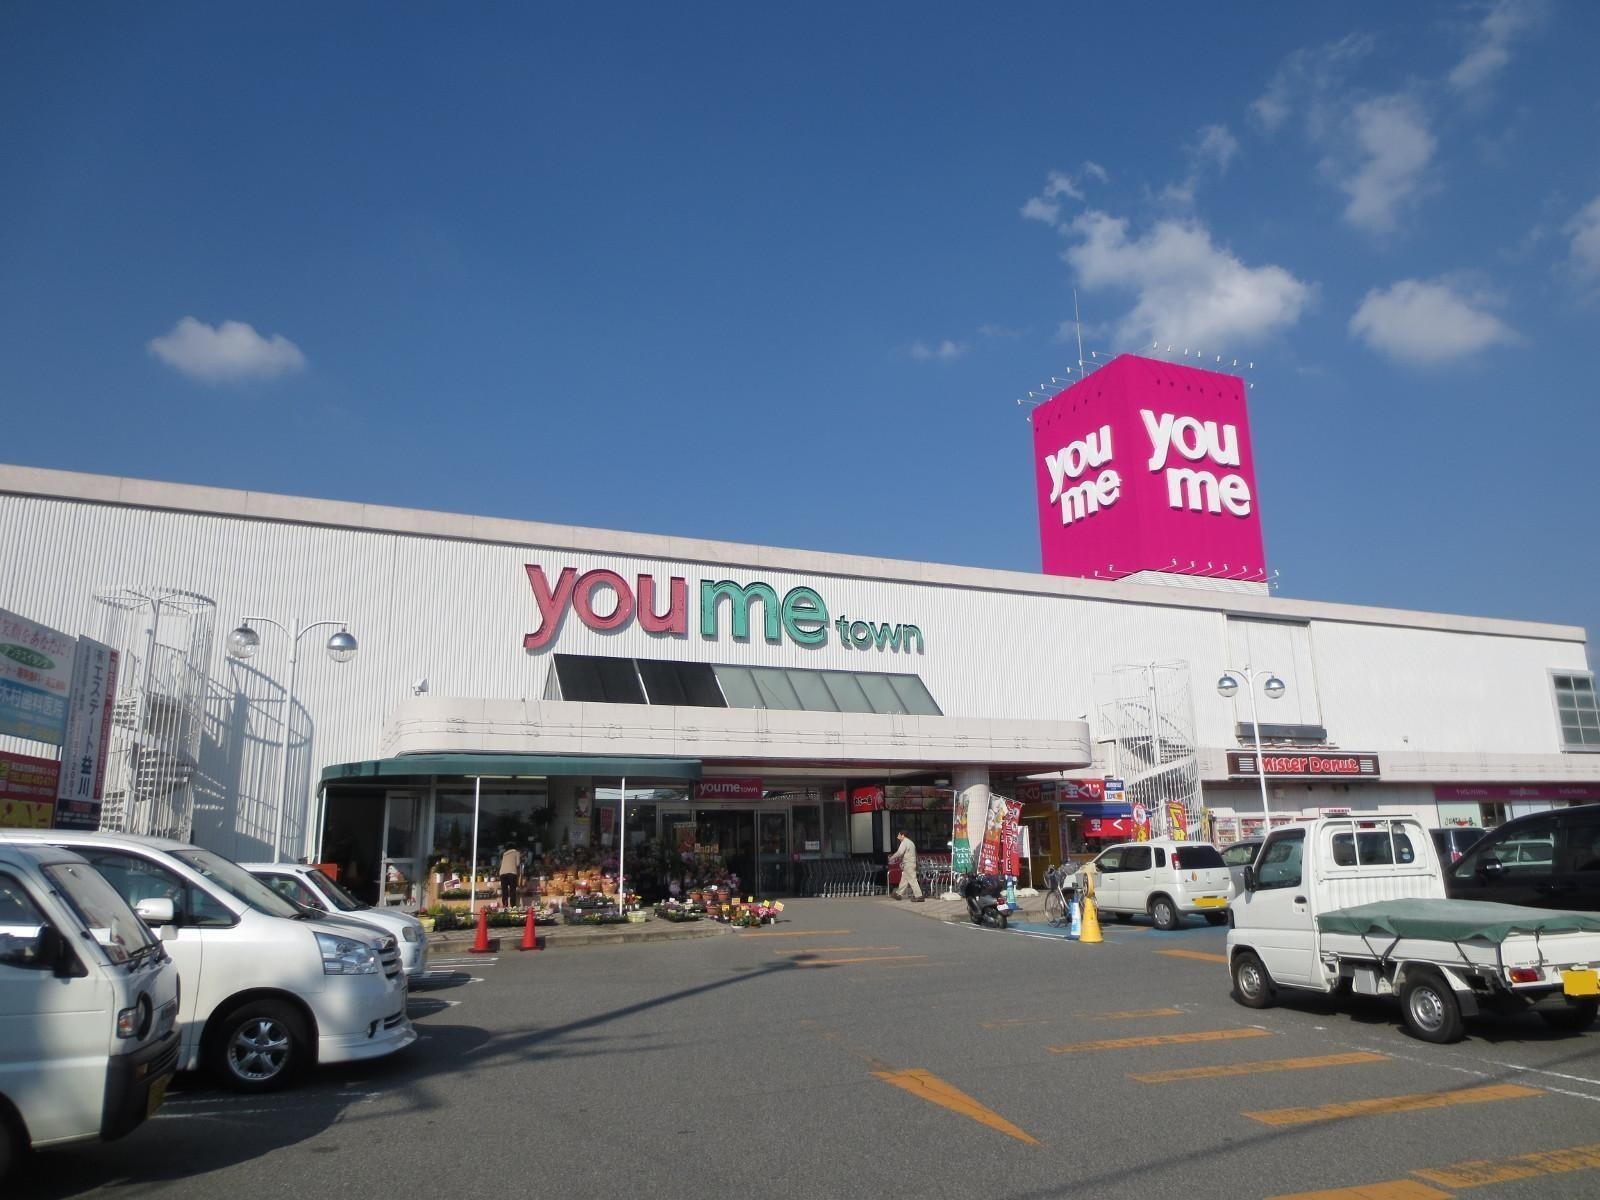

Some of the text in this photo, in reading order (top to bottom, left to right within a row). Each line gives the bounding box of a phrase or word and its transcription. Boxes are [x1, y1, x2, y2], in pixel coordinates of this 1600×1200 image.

[1045, 424, 1113, 503] you
[1140, 408, 1240, 471] you
[1060, 469, 1121, 526] me
[1166, 467, 1251, 516] me
[834, 614, 923, 653] town
[1308, 756, 1360, 773] Donut
[1065, 783, 1101, 798] 宝くじ
